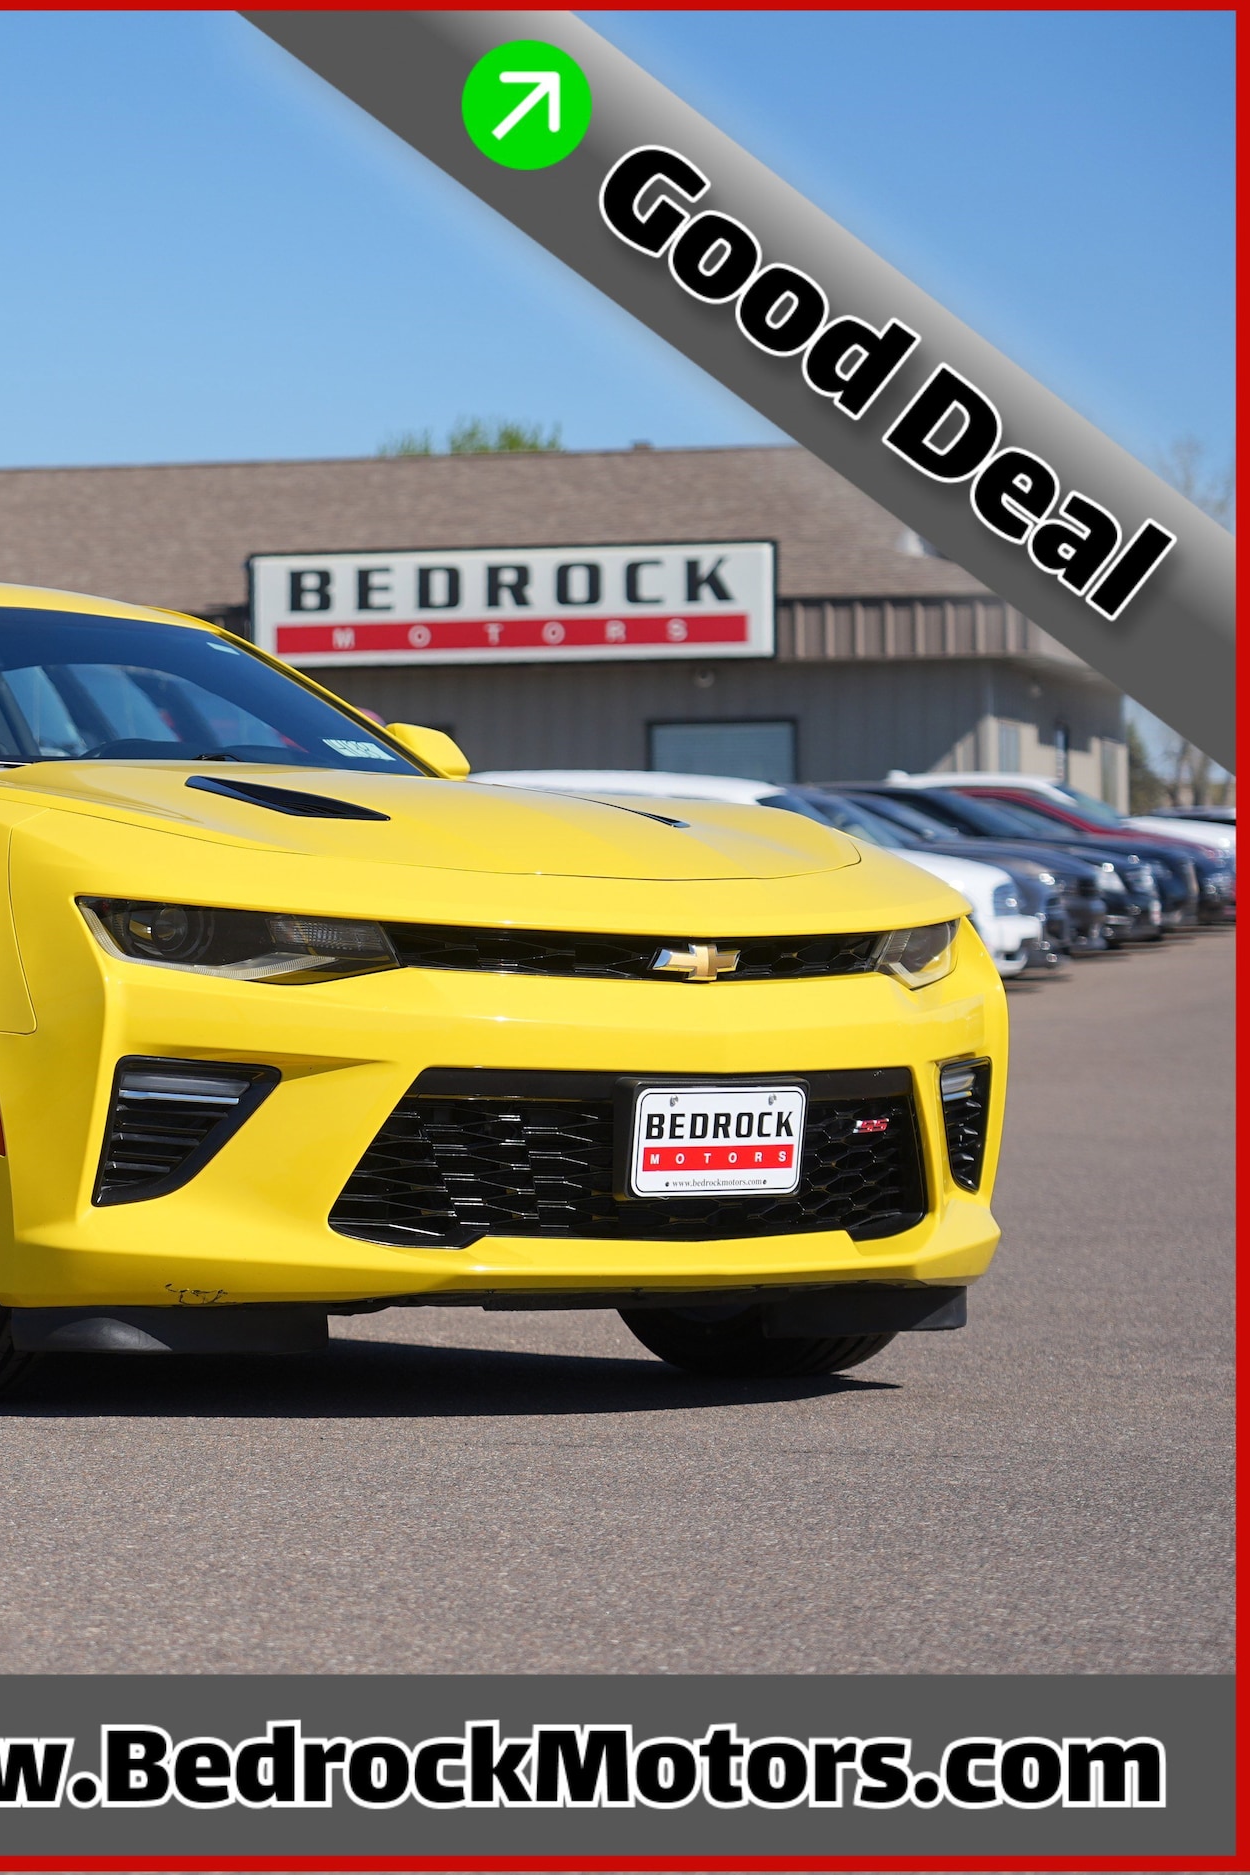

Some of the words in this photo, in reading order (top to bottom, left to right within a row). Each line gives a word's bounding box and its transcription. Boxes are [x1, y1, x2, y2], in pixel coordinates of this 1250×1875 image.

[290, 559, 733, 612] BEDROCK
[333, 620, 688, 648] MOTORS
[645, 1111, 794, 1140] BEDROCK
[650, 1150, 787, 1165] MOTORS
[672, 1178, 762, 1188] www.bedrockmotors.com
